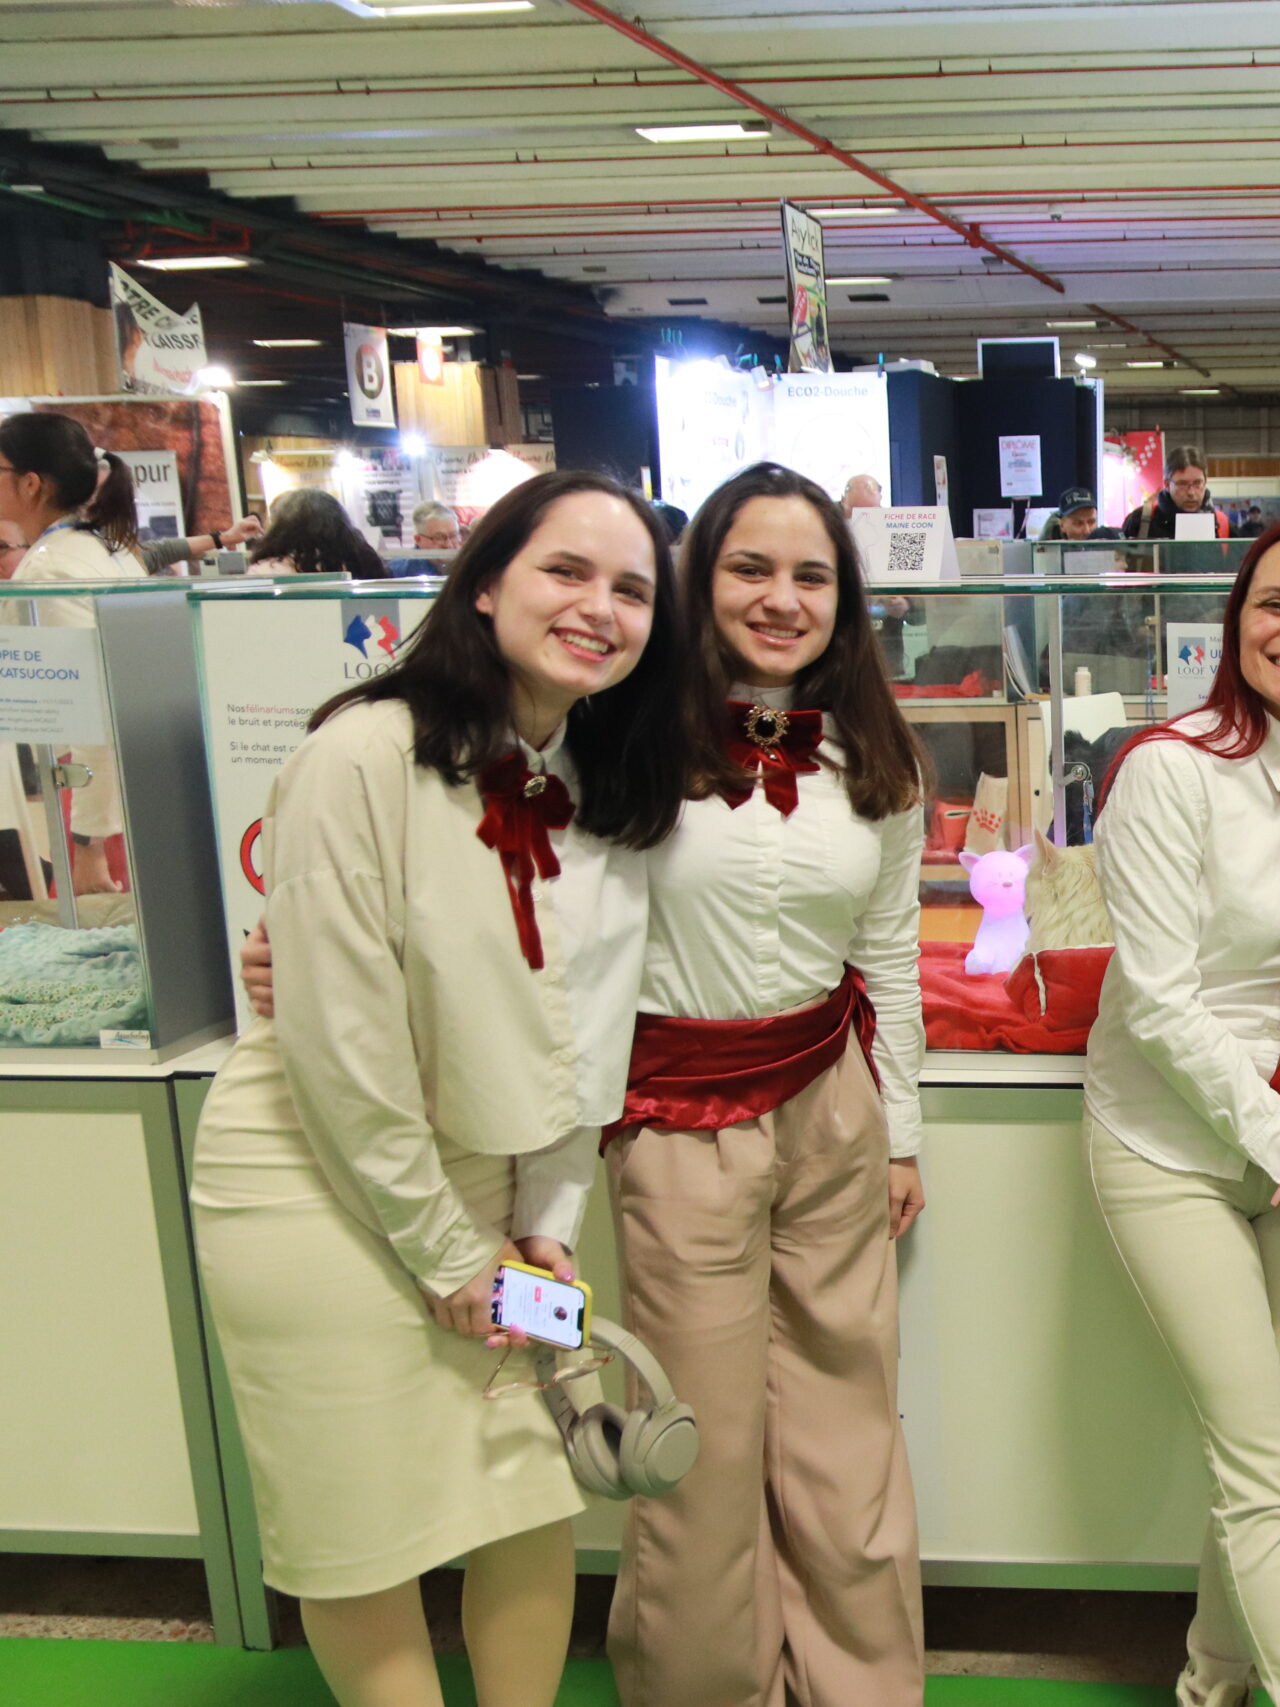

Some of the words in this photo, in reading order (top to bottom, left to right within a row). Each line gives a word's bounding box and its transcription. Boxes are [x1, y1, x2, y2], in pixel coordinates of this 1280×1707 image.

[787, 387, 868, 398] ECO2-Douche
[0, 650, 20, 661] PIE
[24, 650, 42, 661] DE
[344, 662, 397, 680] LOO
[1178, 666, 1205, 675] LOOF
[227, 704, 245, 714] Nos
[246, 704, 295, 715] félinariums
[228, 717, 236, 726] le
[239, 717, 260, 726] bruit
[262, 718, 272, 727] et
[230, 741, 239, 751] Si
[241, 742, 249, 751] le
[251, 742, 270, 752] chat
[273, 744, 287, 753] est
[231, 756, 243, 764] un
